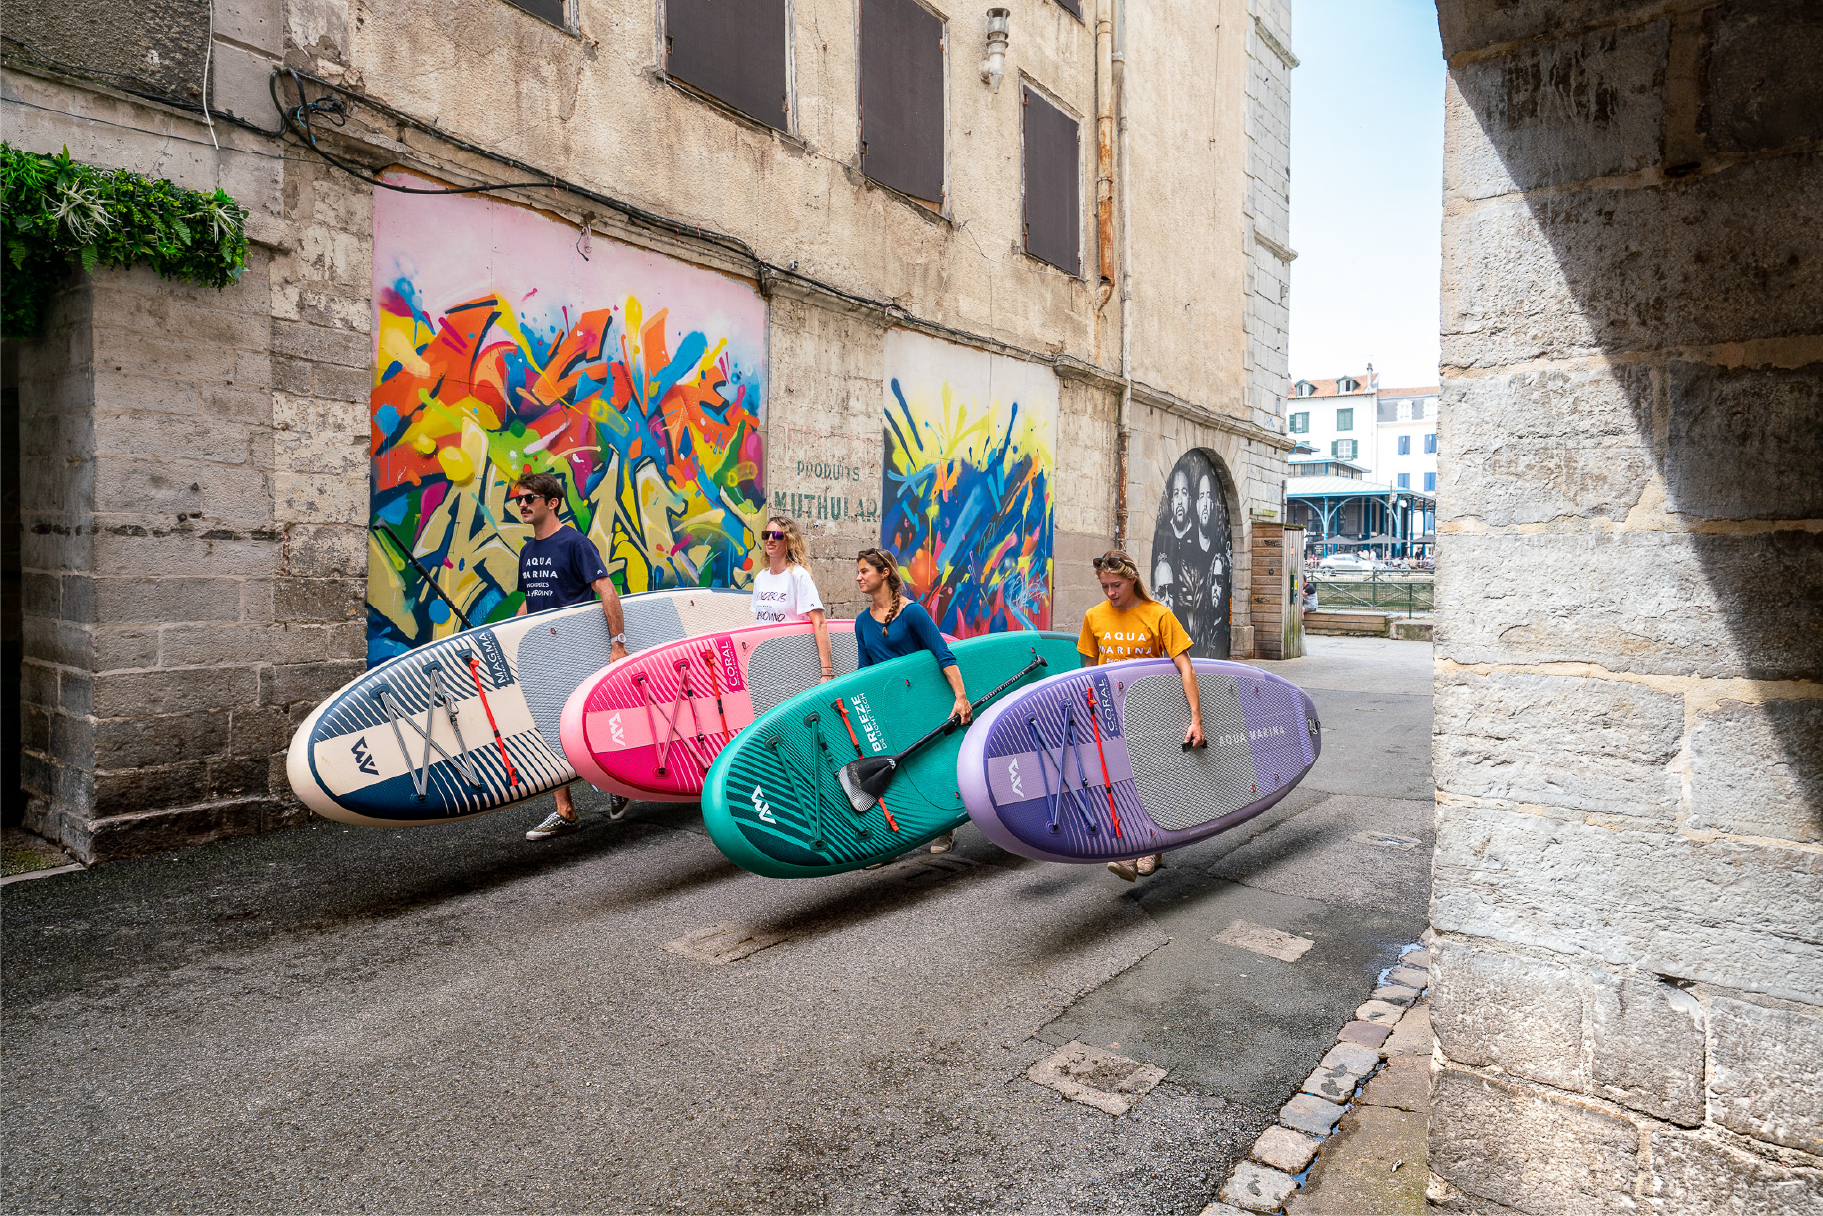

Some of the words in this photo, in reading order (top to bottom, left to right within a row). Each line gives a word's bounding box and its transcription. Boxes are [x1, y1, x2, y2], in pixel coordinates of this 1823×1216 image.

[525, 557, 552, 567] AQUA
[1103, 631, 1147, 641] AQUA
[479, 632, 506, 683] MAGMA
[720, 641, 738, 686] CORAL
[859, 692, 872, 715] TECH
[1098, 679, 1115, 731] CORAL
[850, 694, 882, 752] BREEZE
[868, 715, 883, 737] LIGHT
[1218, 732, 1247, 747] AQUA
[1249, 725, 1286, 741] MARINA
